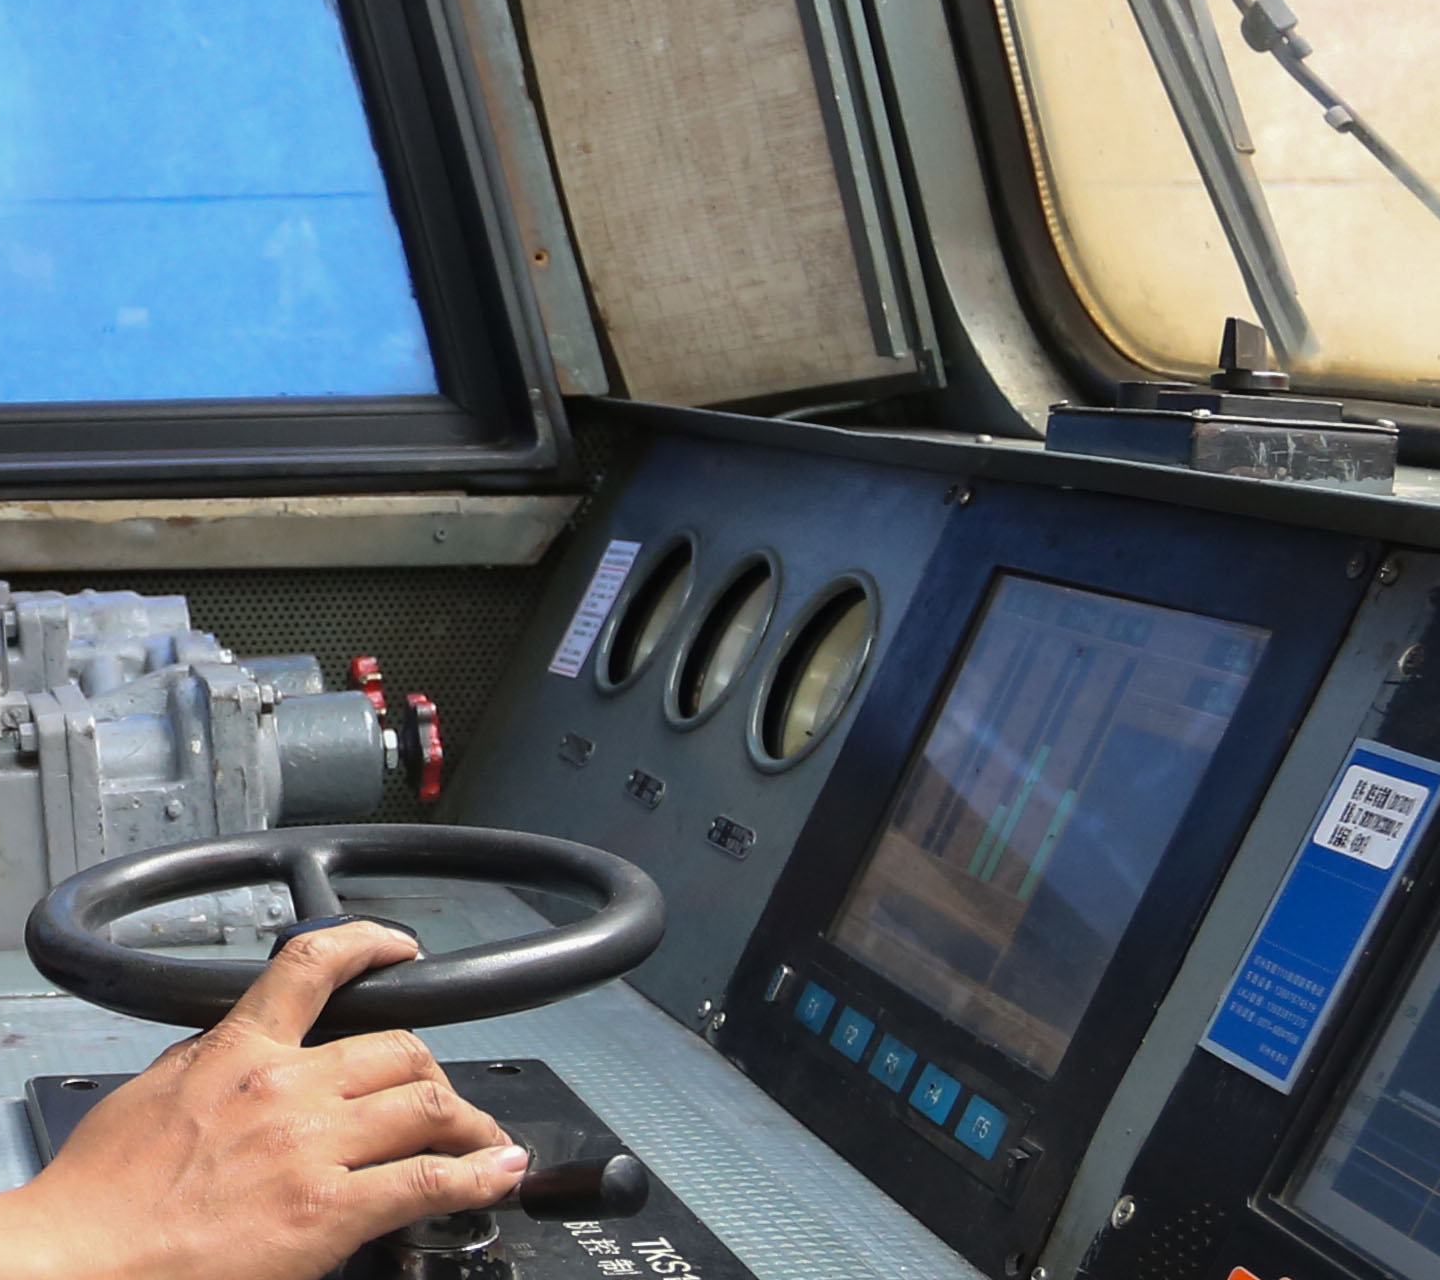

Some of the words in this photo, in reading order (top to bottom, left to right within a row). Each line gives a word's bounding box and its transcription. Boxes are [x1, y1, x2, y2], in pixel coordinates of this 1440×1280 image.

[805, 997, 820, 1018] F1
[845, 1023, 859, 1046] F2
[884, 1052, 900, 1075] F3
[926, 1082, 942, 1105] F4
[972, 1115, 992, 1140] F5
